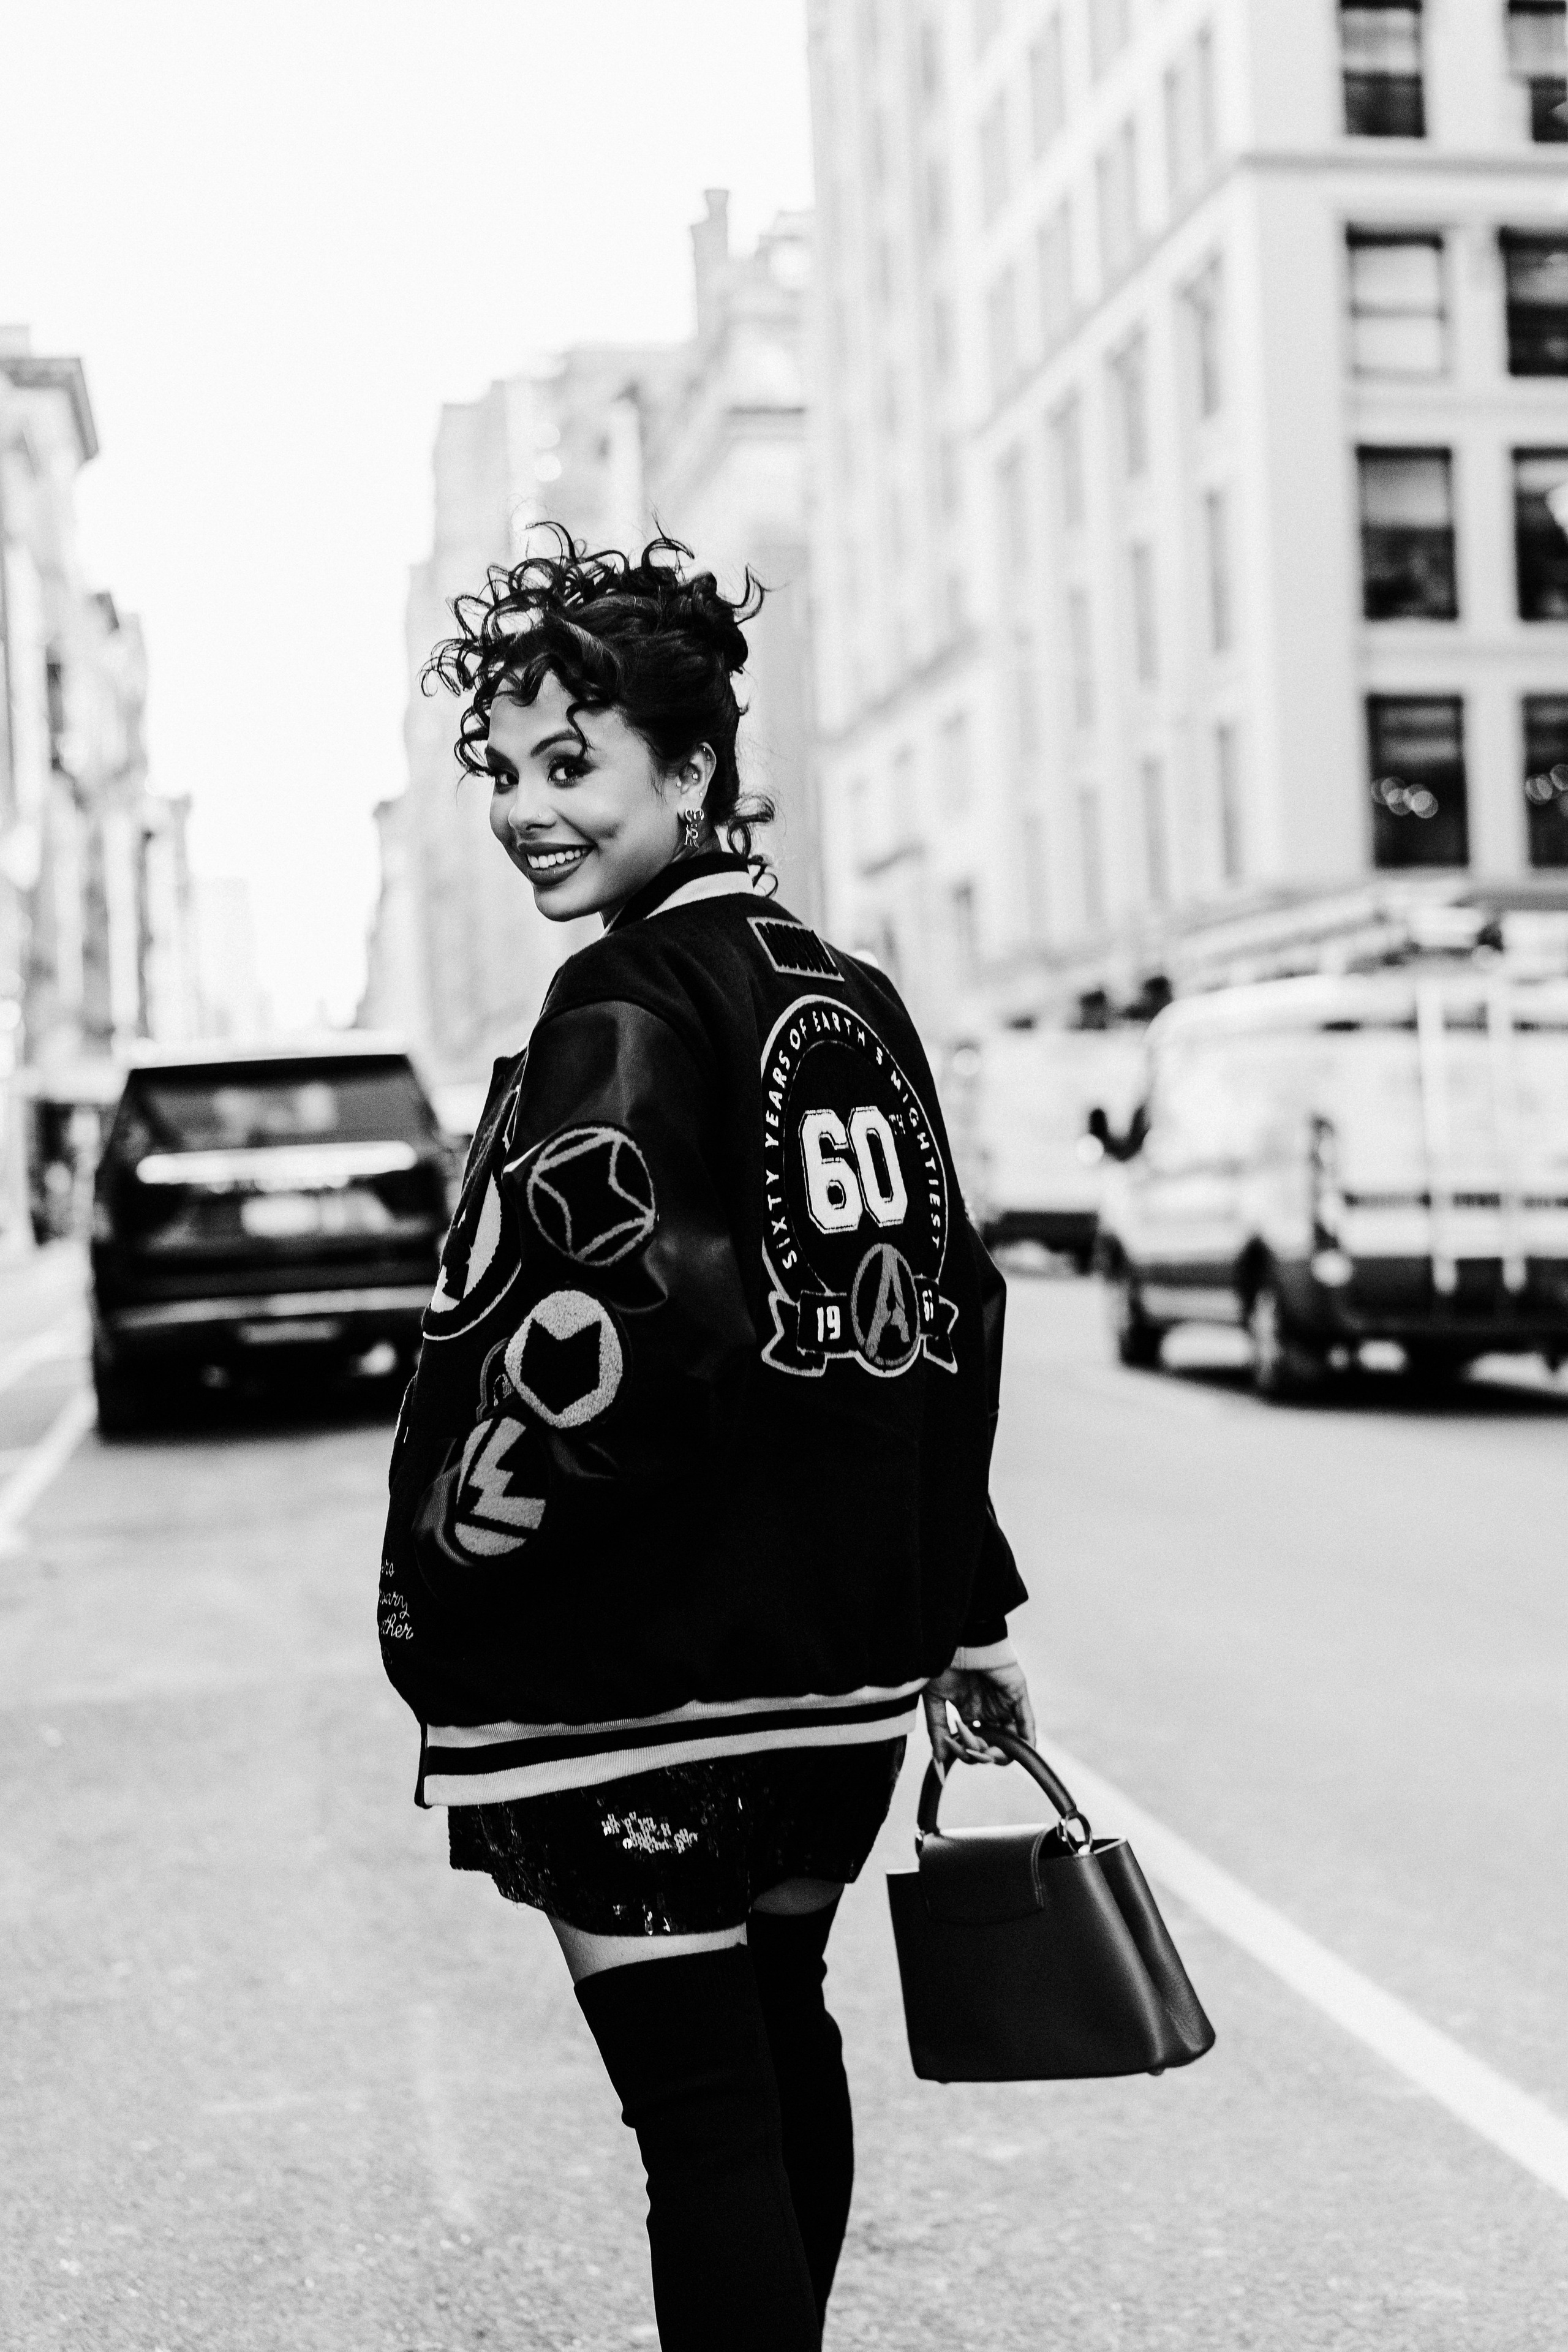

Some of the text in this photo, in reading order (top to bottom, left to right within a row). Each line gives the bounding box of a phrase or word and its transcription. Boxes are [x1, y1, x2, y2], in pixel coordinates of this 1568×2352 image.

[790, 1017, 807, 1050] OF
[812, 1011, 883, 1066] EARTHS
[764, 1049, 791, 1148] YEARS
[766, 1169, 797, 1269] SIXTY
[817, 1305, 841, 1343] 19
